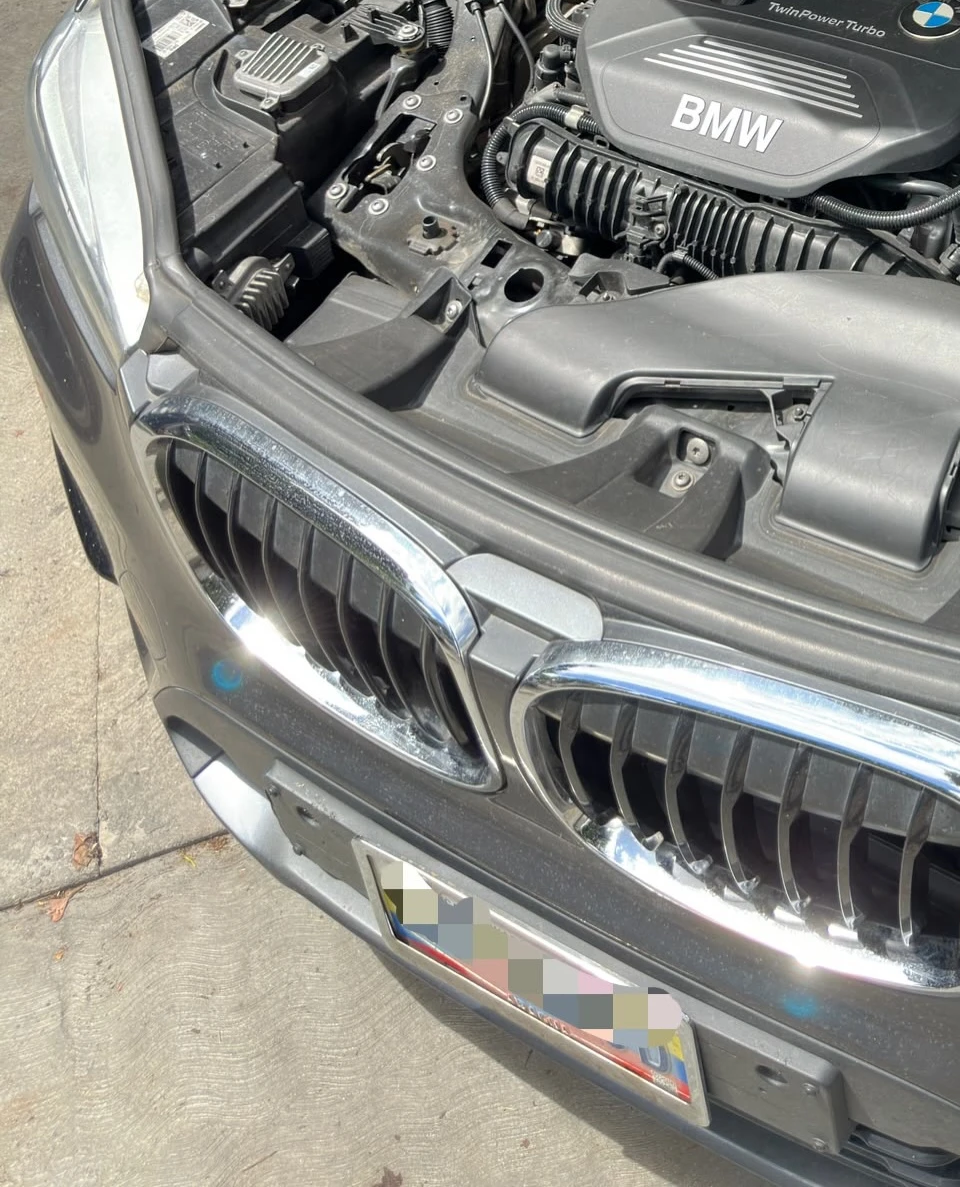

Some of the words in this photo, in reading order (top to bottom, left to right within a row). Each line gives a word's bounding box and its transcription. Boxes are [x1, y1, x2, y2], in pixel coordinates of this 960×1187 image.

[768, 1, 844, 28] TwinPower
[845, 20, 886, 38] Turbo
[670, 93, 784, 153] BMW
